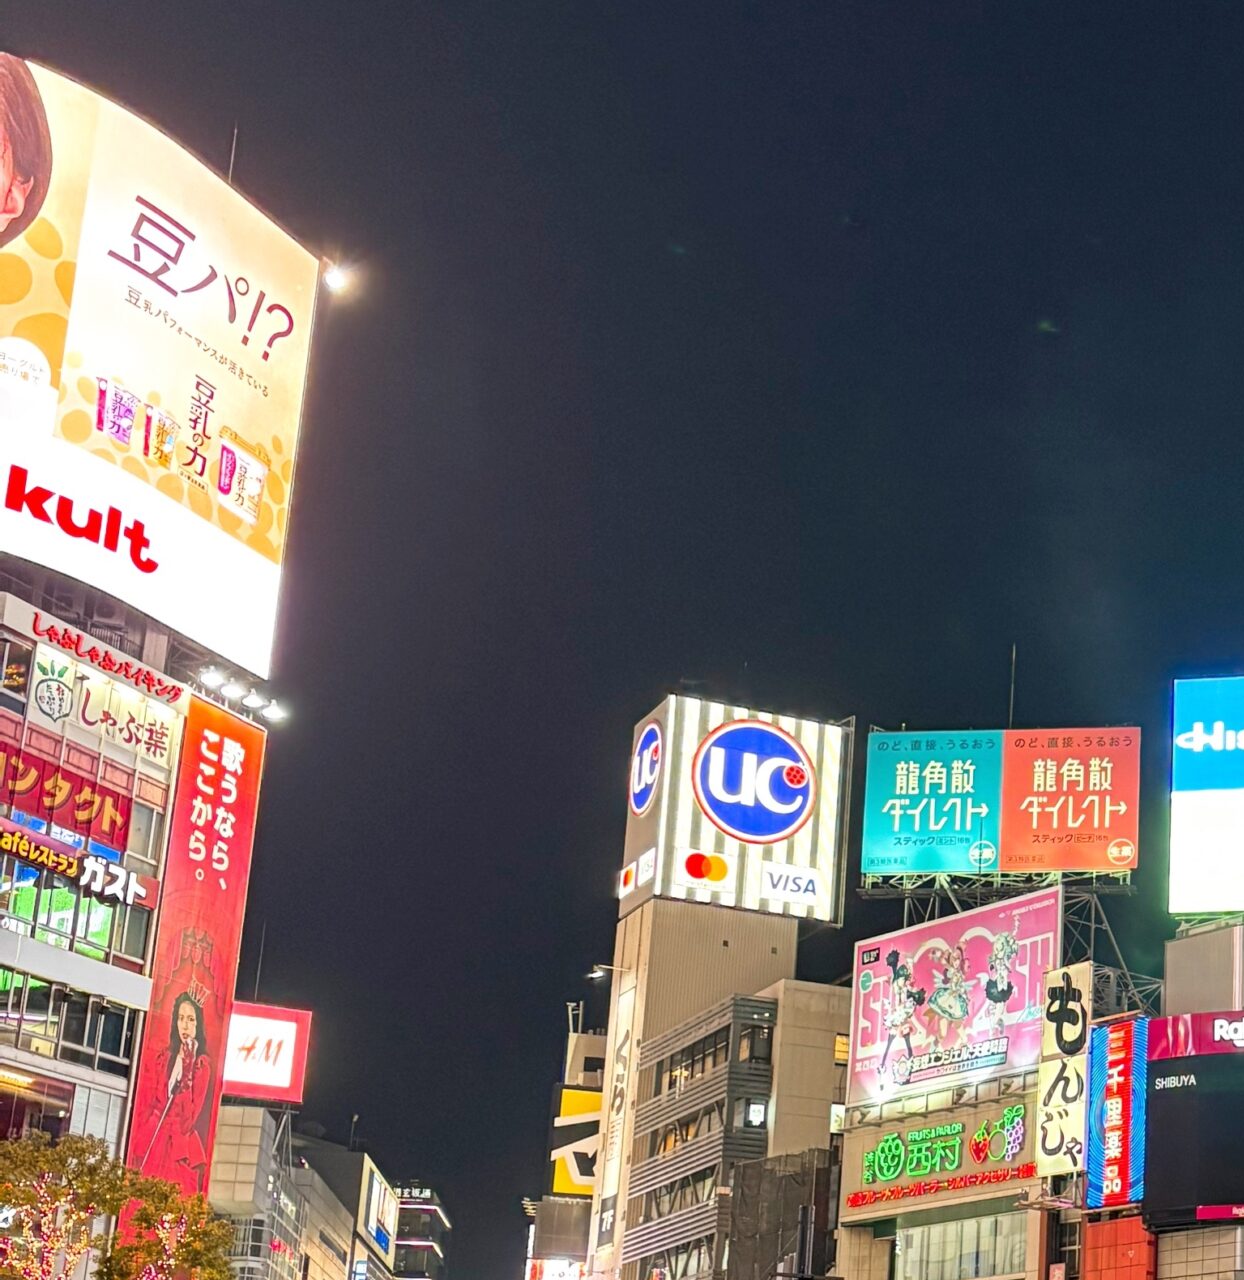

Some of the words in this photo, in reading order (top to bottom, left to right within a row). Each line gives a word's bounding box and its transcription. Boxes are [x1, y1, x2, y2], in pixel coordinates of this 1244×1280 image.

[107, 194, 294, 362] 豆パ!?
[182, 374, 217, 478] 豆乳の力
[5, 464, 159, 573] kult
[81, 688, 169, 758] しゃぶ葉
[707, 746, 806, 815] UC
[895, 759, 976, 795] 龍角散
[1033, 757, 1113, 792] 龍角散
[188, 729, 219, 881] ここから。
[211, 735, 246, 890] 歌うなら、
[881, 797, 989, 832] ダイレクト
[1019, 795, 1128, 829] ダイレクト
[893, 836, 936, 847] スティック
[1032, 833, 1074, 844] スティック
[0, 829, 78, 878] aféレストラン
[79, 856, 147, 905] ガスト
[767, 872, 818, 896] VISA
[1041, 972, 1086, 1167] もんじゃ
[1155, 1075, 1196, 1089] SHIBUYA
[906, 1136, 962, 1176] 西村
[602, 1210, 613, 1232] 7F
